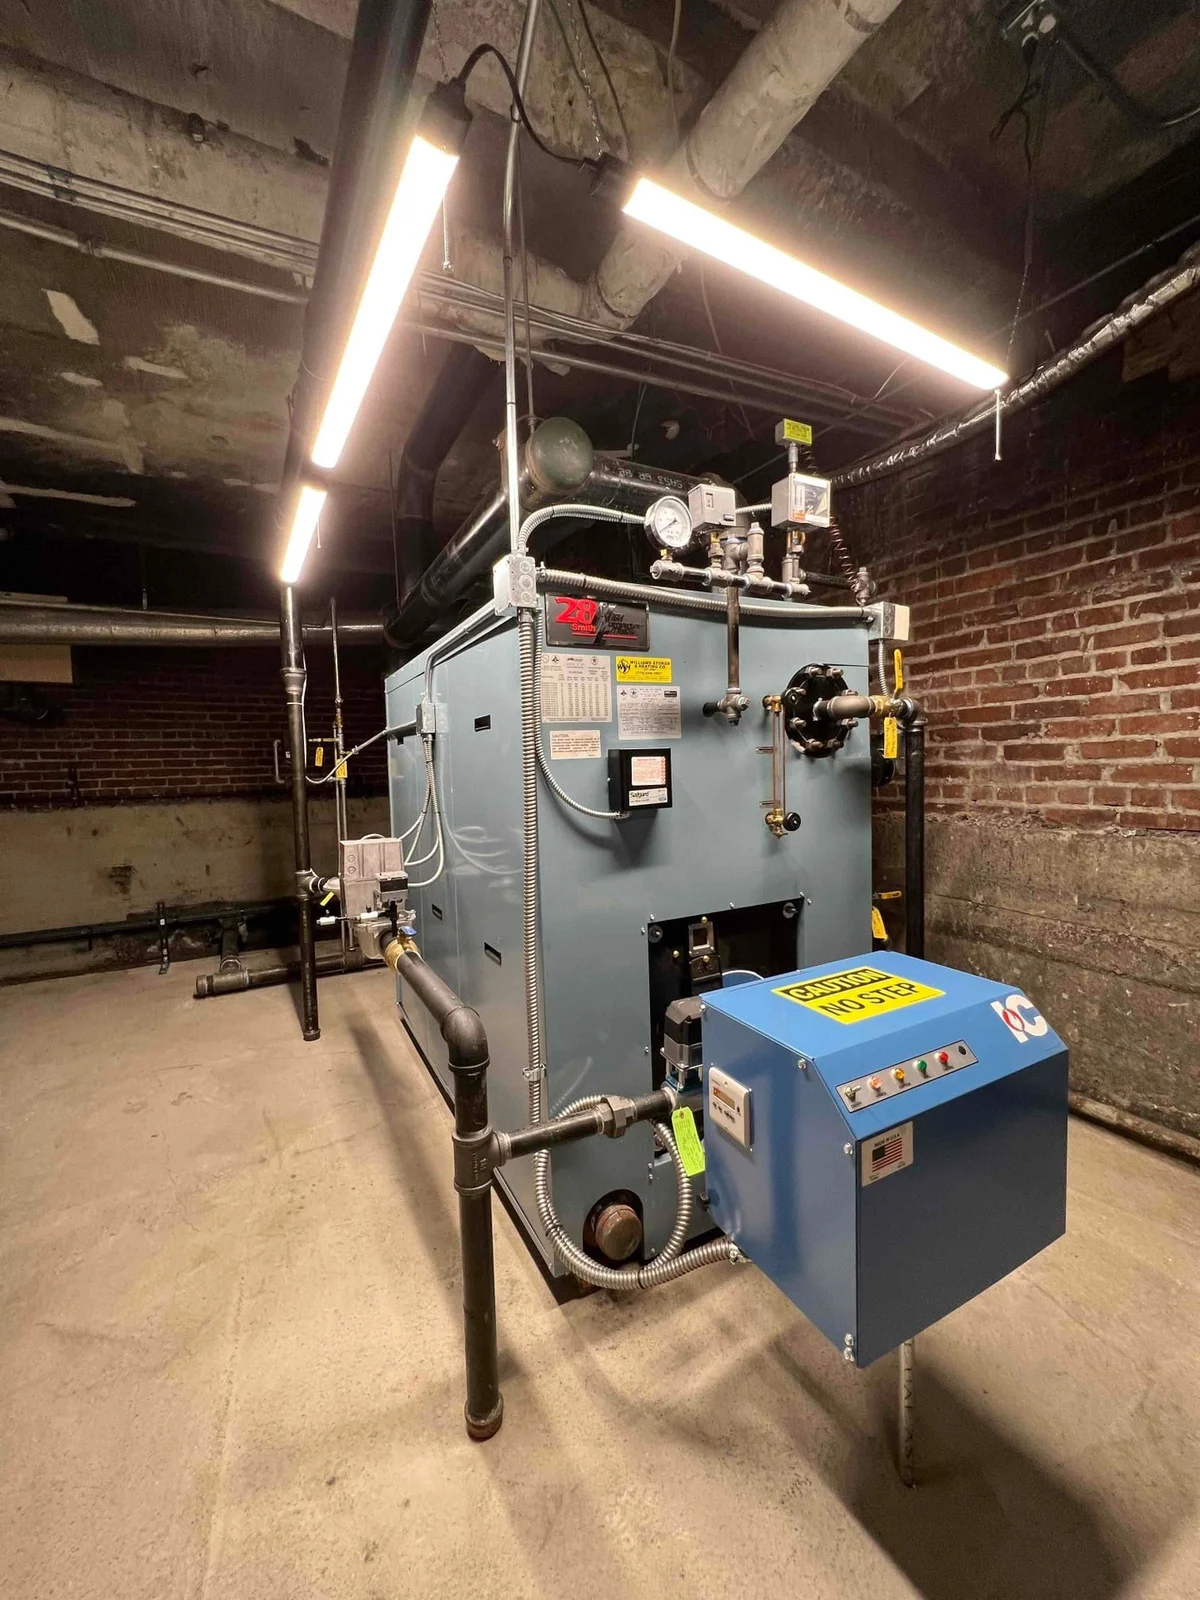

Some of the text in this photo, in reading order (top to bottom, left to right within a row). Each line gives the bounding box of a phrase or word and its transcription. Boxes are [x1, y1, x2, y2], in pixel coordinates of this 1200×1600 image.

[554, 596, 597, 625] 28
[571, 623, 596, 632] Smith
[788, 970, 887, 1000] CAUTION
[818, 982, 919, 1016] NO STEP
